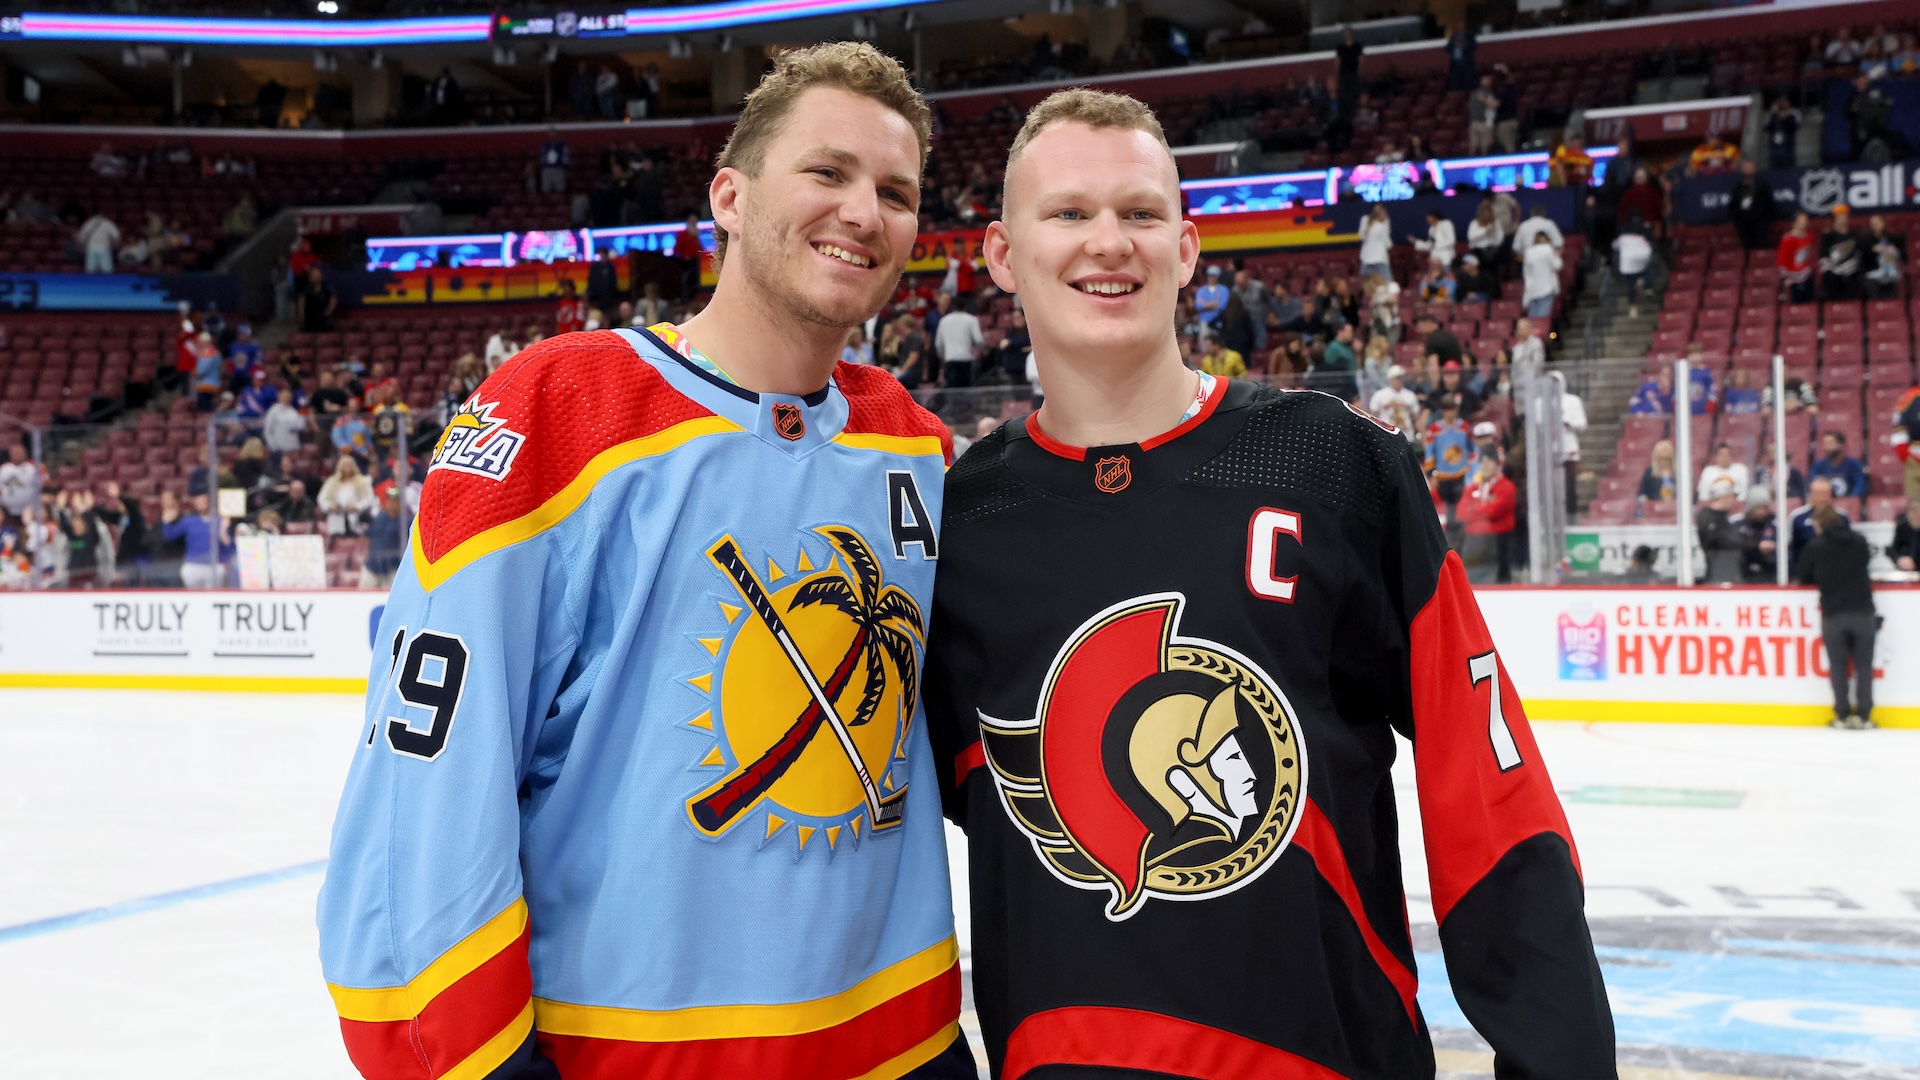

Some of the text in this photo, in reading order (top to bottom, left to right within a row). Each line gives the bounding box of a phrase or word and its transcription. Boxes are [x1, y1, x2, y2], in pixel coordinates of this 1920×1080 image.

[781, 413, 797, 431] NHL
[432, 425, 524, 479] FLA
[1103, 465, 1124, 486] NHL
[886, 469, 939, 560] A
[1245, 506, 1303, 604] C
[93, 602, 188, 631] TRULY
[214, 602, 314, 632] TRULY
[1736, 607, 1823, 628] HEAL
[1467, 648, 1524, 774] 7
